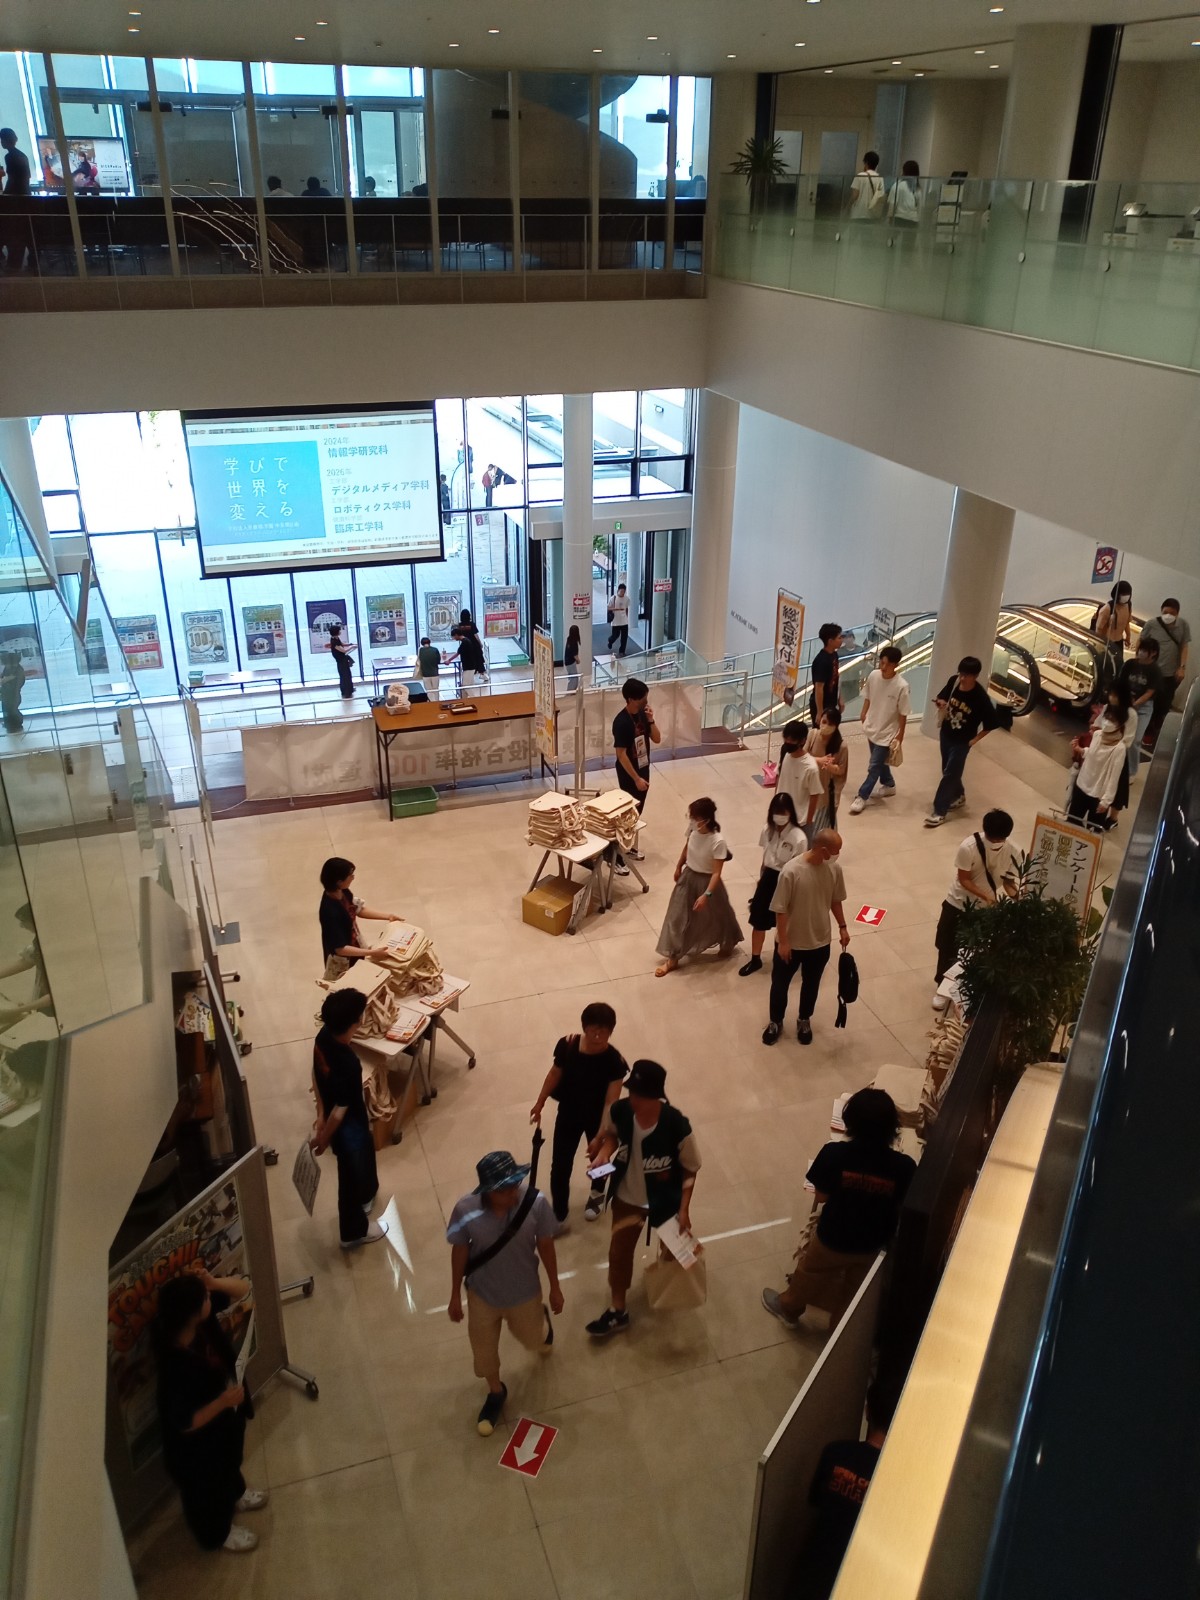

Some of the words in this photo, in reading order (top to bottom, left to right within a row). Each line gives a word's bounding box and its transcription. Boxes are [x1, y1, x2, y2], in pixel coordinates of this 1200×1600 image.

[328, 445, 388, 458] 情報学研究科
[223, 456, 289, 476] 学びで
[226, 478, 290, 499] 世界を
[331, 480, 430, 496] デジタルメディア学科
[229, 502, 294, 522] 変える
[333, 500, 411, 514] ロボティクス学科
[334, 521, 384, 534] 臨床工学科
[779, 604, 796, 663] 総合受付
